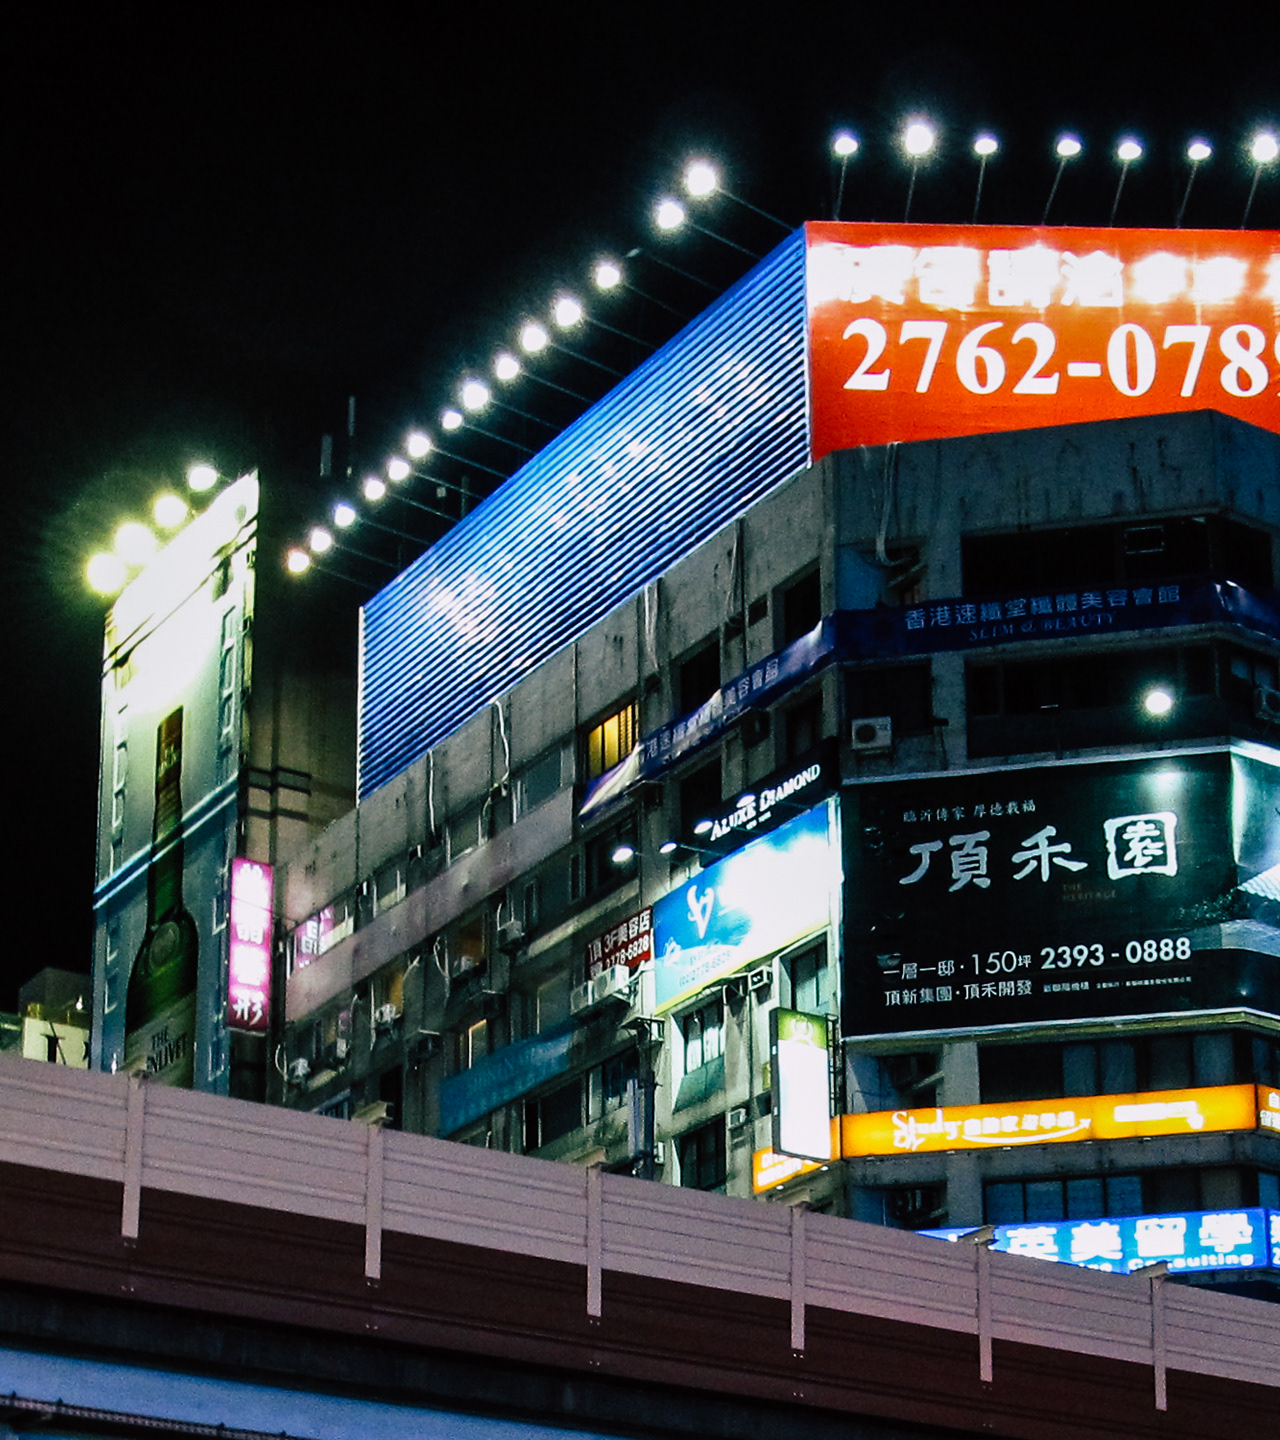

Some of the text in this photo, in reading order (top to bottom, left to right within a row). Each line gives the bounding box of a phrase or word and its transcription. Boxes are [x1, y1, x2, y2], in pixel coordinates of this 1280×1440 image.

[1044, 611, 1117, 632] BEAUTY
[710, 764, 821, 842] ALUXE DIAMOND
[1007, 1213, 1253, 1262] 英美留學
[1128, 1253, 1254, 1271] Csulting
